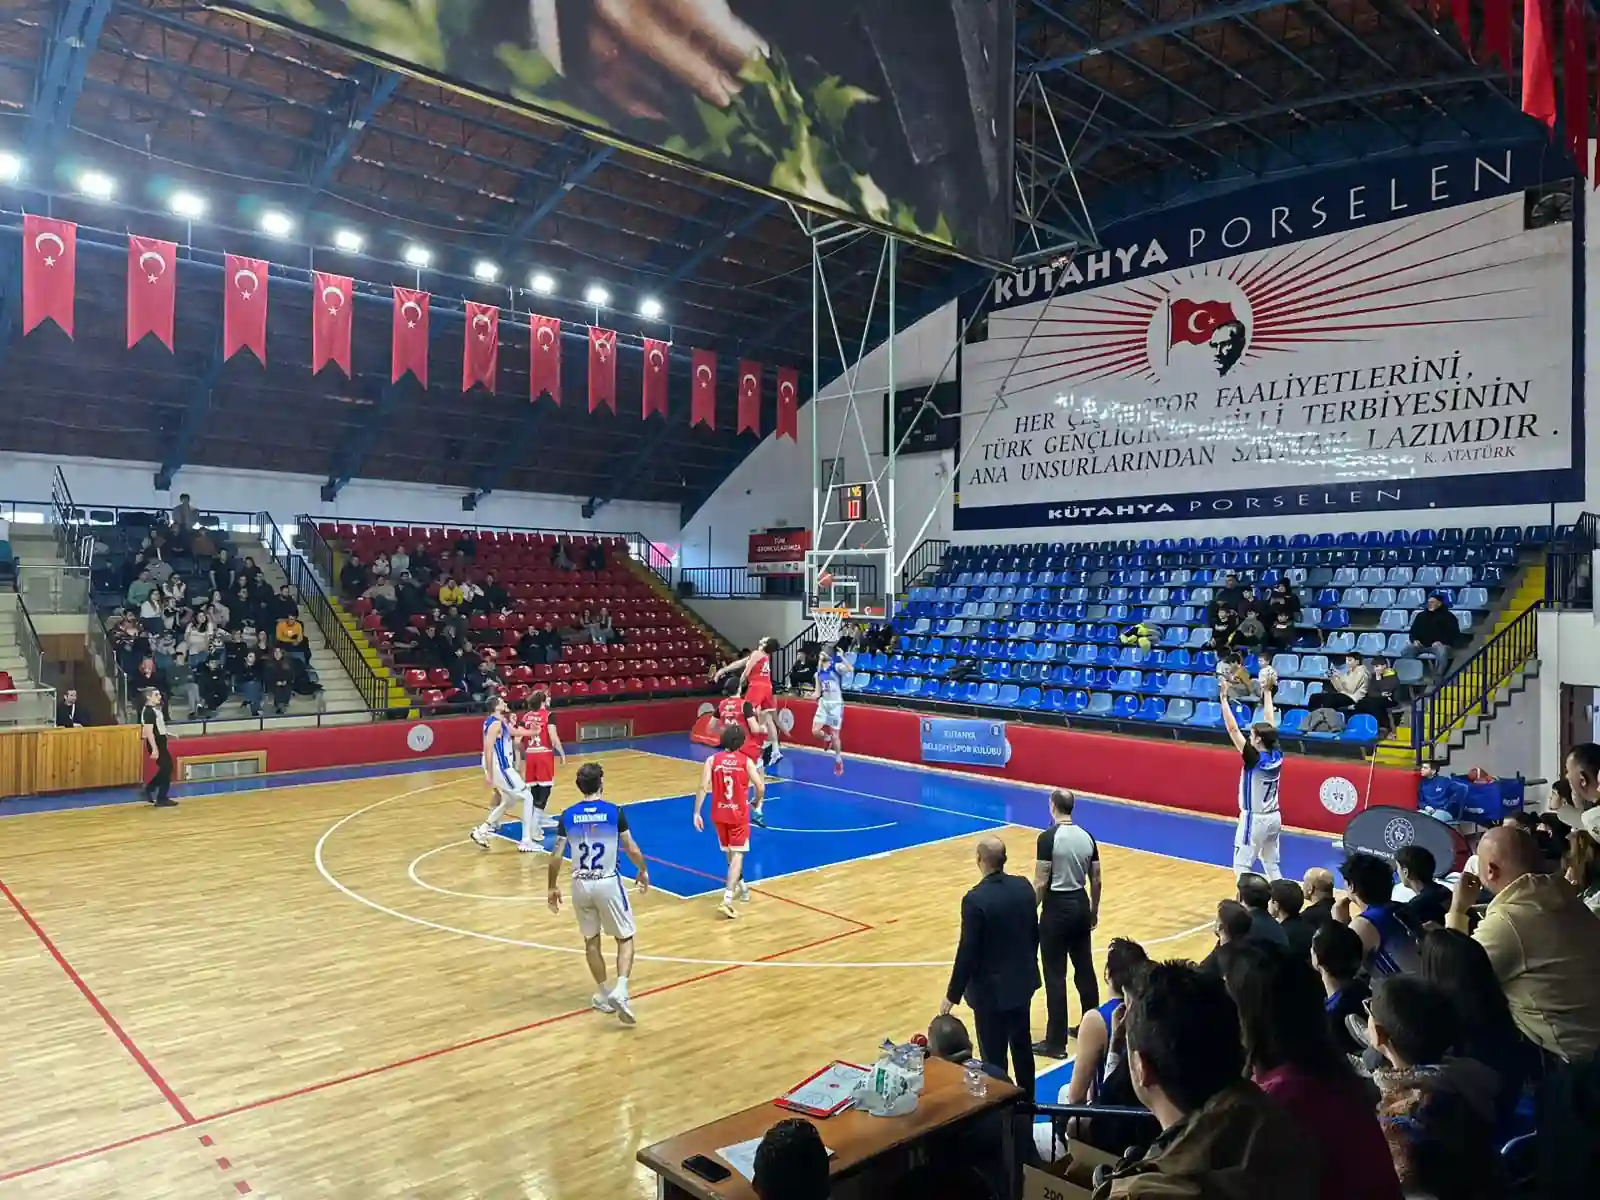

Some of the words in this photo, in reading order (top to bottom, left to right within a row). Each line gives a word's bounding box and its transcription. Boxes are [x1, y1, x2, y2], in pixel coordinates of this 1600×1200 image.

[994, 239, 1168, 305] KÜTAHYA
[1189, 150, 1512, 258] PORSELEN
[981, 437, 1033, 461] TÜRK
[1303, 376, 1531, 427] TERBİYESİNİN
[1014, 412, 1055, 434] HER
[968, 466, 1009, 486] ANA
[1020, 443, 1216, 482] UNSURLARINDAN
[1443, 444, 1518, 463] ATATÜRK
[1047, 502, 1175, 521] KÜTAHYA
[1188, 488, 1402, 513] PORSELEN
[723, 775, 734, 801] 3
[578, 842, 606, 871] 22
